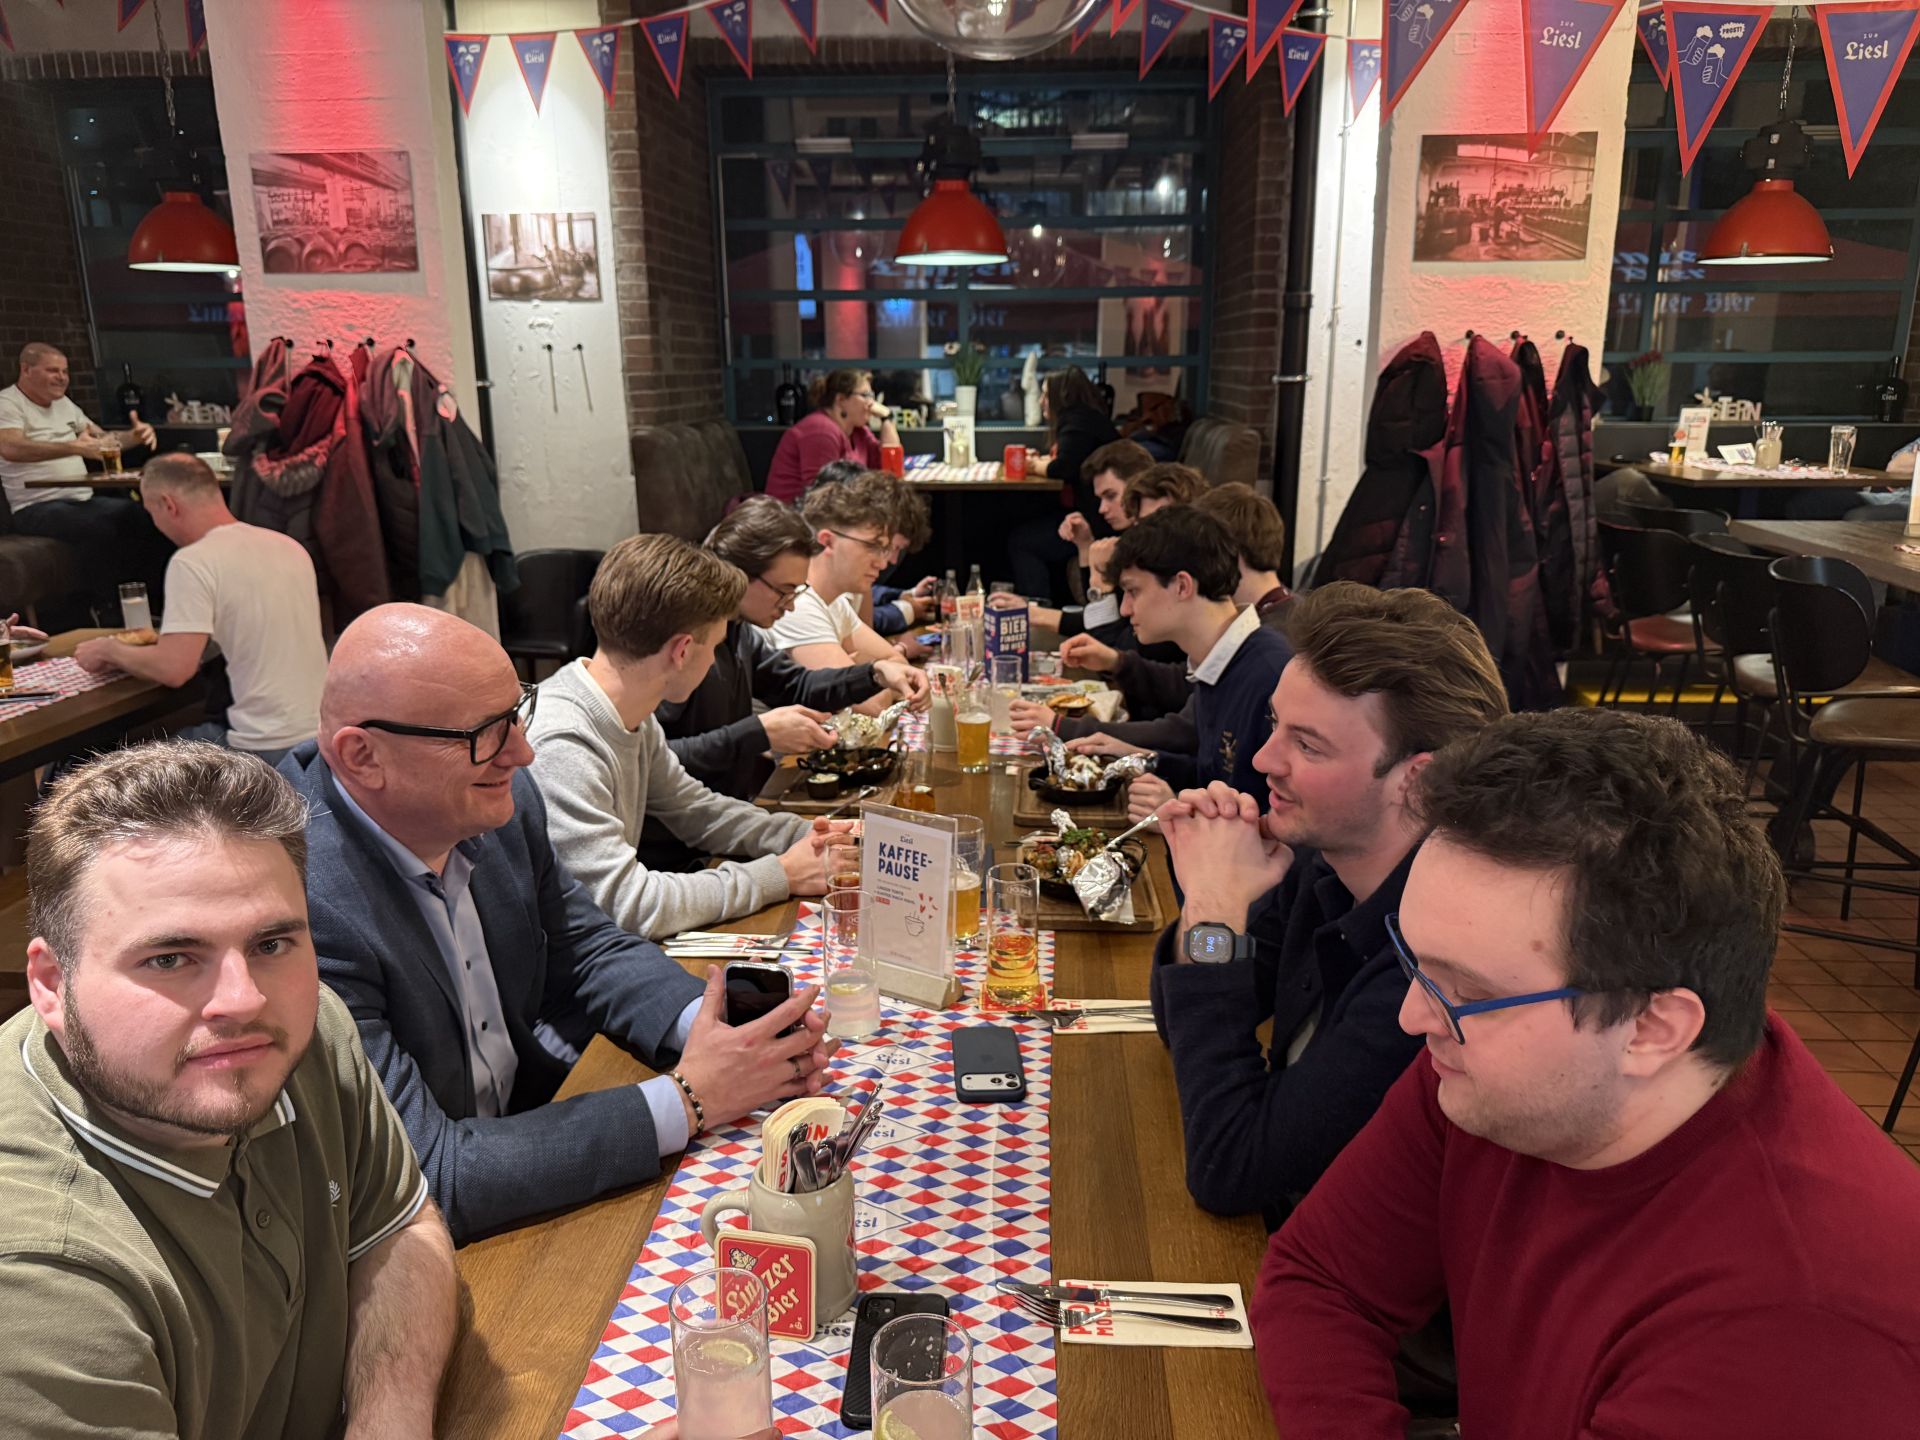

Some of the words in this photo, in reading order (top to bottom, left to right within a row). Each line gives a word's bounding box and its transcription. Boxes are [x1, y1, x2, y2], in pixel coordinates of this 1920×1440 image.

[1539, 26, 1582, 49] Liesl
[1844, 40, 1889, 61] Liesl
[1000, 620, 1027, 635] BIER
[879, 842, 933, 868] KAFFEE-
[878, 858, 919, 882] PAUSE
[876, 1053, 911, 1065] Liesl
[726, 1253, 795, 1316] Linzer
